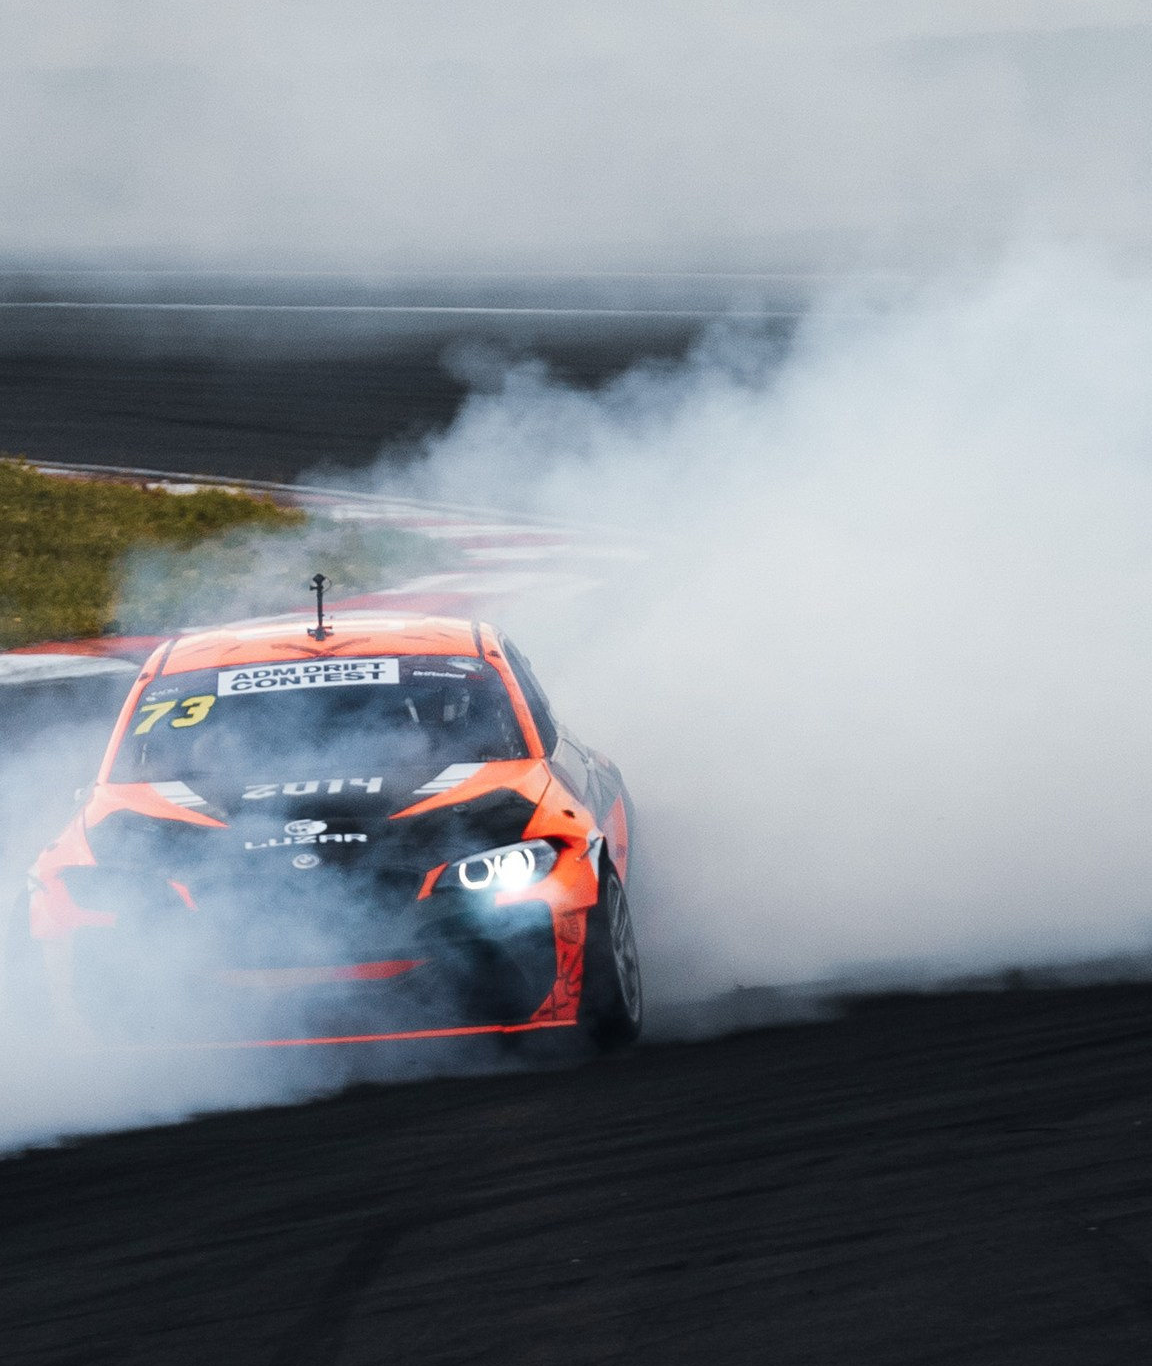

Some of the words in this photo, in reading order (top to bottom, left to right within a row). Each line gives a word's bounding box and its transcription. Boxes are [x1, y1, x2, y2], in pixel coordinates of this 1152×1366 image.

[230, 670, 386, 692] CONTEST
[231, 666, 296, 681] ADM
[303, 662, 386, 673] DRIFT
[134, 695, 217, 736] 73
[242, 777, 384, 800] 2014
[244, 833, 368, 850] LUZAR
